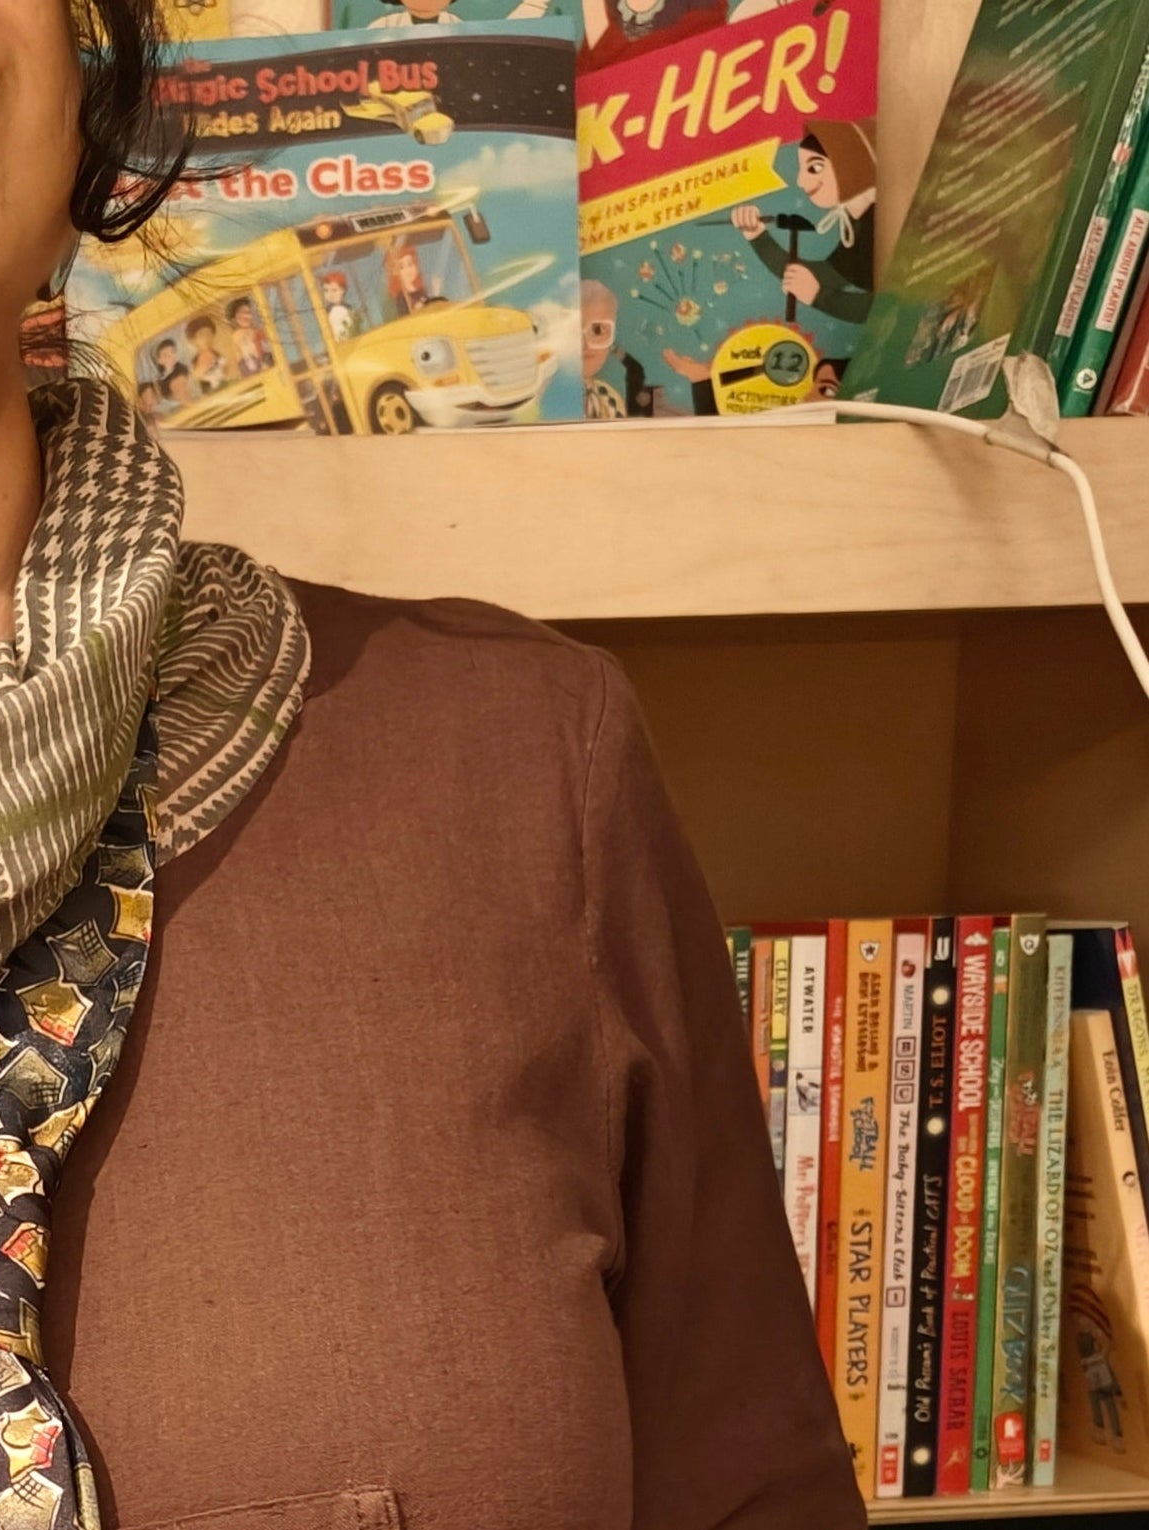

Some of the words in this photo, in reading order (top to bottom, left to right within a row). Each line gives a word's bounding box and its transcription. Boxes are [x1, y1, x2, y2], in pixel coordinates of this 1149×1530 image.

[255, 64, 371, 104] School
[378, 59, 439, 92] Bus
[268, 105, 341, 135] Again
[219, 165, 294, 200] the
[309, 155, 432, 195] Class
[606, 158, 750, 220] INSPIRATIONAL
[653, 196, 702, 226] STEM
[770, 351, 803, 372] 12
[736, 950, 749, 985] THE
[774, 959, 788, 1016] CLEARY
[802, 966, 815, 1034] ATWATER
[902, 984, 915, 1031] MARTIN
[960, 953, 987, 1037] WAYSIDE
[931, 1014, 947, 1068] ELIOT
[958, 1040, 982, 1111] SCHOOL
[1102, 1051, 1115, 1084] Eoin
[898, 1110, 910, 1138] The
[1049, 1089, 1064, 1124] THE
[1108, 1088, 1126, 1132] Colfer
[955, 1155, 976, 1212] CLOUD
[1045, 1128, 1062, 1194] LIZARD
[1045, 1199, 1059, 1224] OF
[851, 1221, 872, 1285] STAR
[950, 1225, 973, 1279] DOOM
[1044, 1227, 1058, 1255] OZ
[892, 1248, 906, 1282] Club
[1042, 1258, 1057, 1288] and
[847, 1294, 871, 1387] PLAYERS
[949, 1311, 969, 1360] LOUIS
[1039, 1344, 1054, 1399] Stories
[915, 1395, 932, 1423] Old
[946, 1367, 967, 1432] SACHAR
